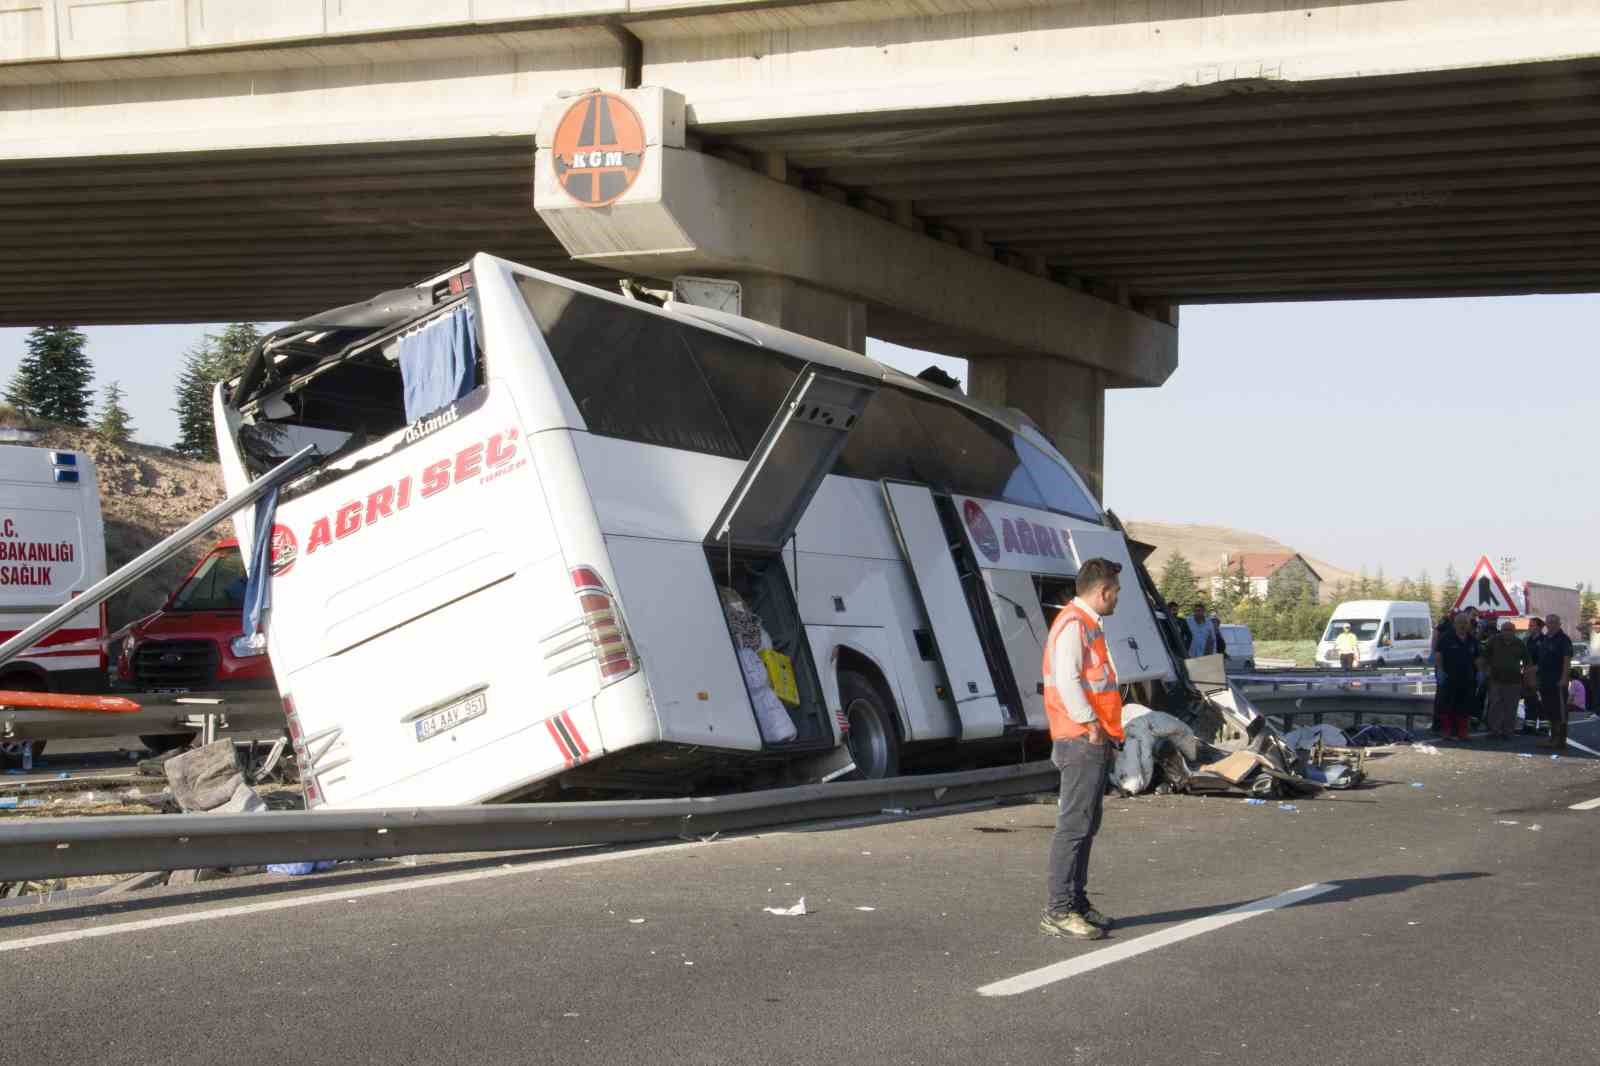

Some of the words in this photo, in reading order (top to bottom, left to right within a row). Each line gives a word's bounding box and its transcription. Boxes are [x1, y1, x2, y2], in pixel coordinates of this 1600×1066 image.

[573, 151, 623, 169] KGM
[0, 541, 74, 562] BAKANLIĞI
[1, 563, 52, 585] SAĞLIK
[440, 708, 459, 728] AAV
